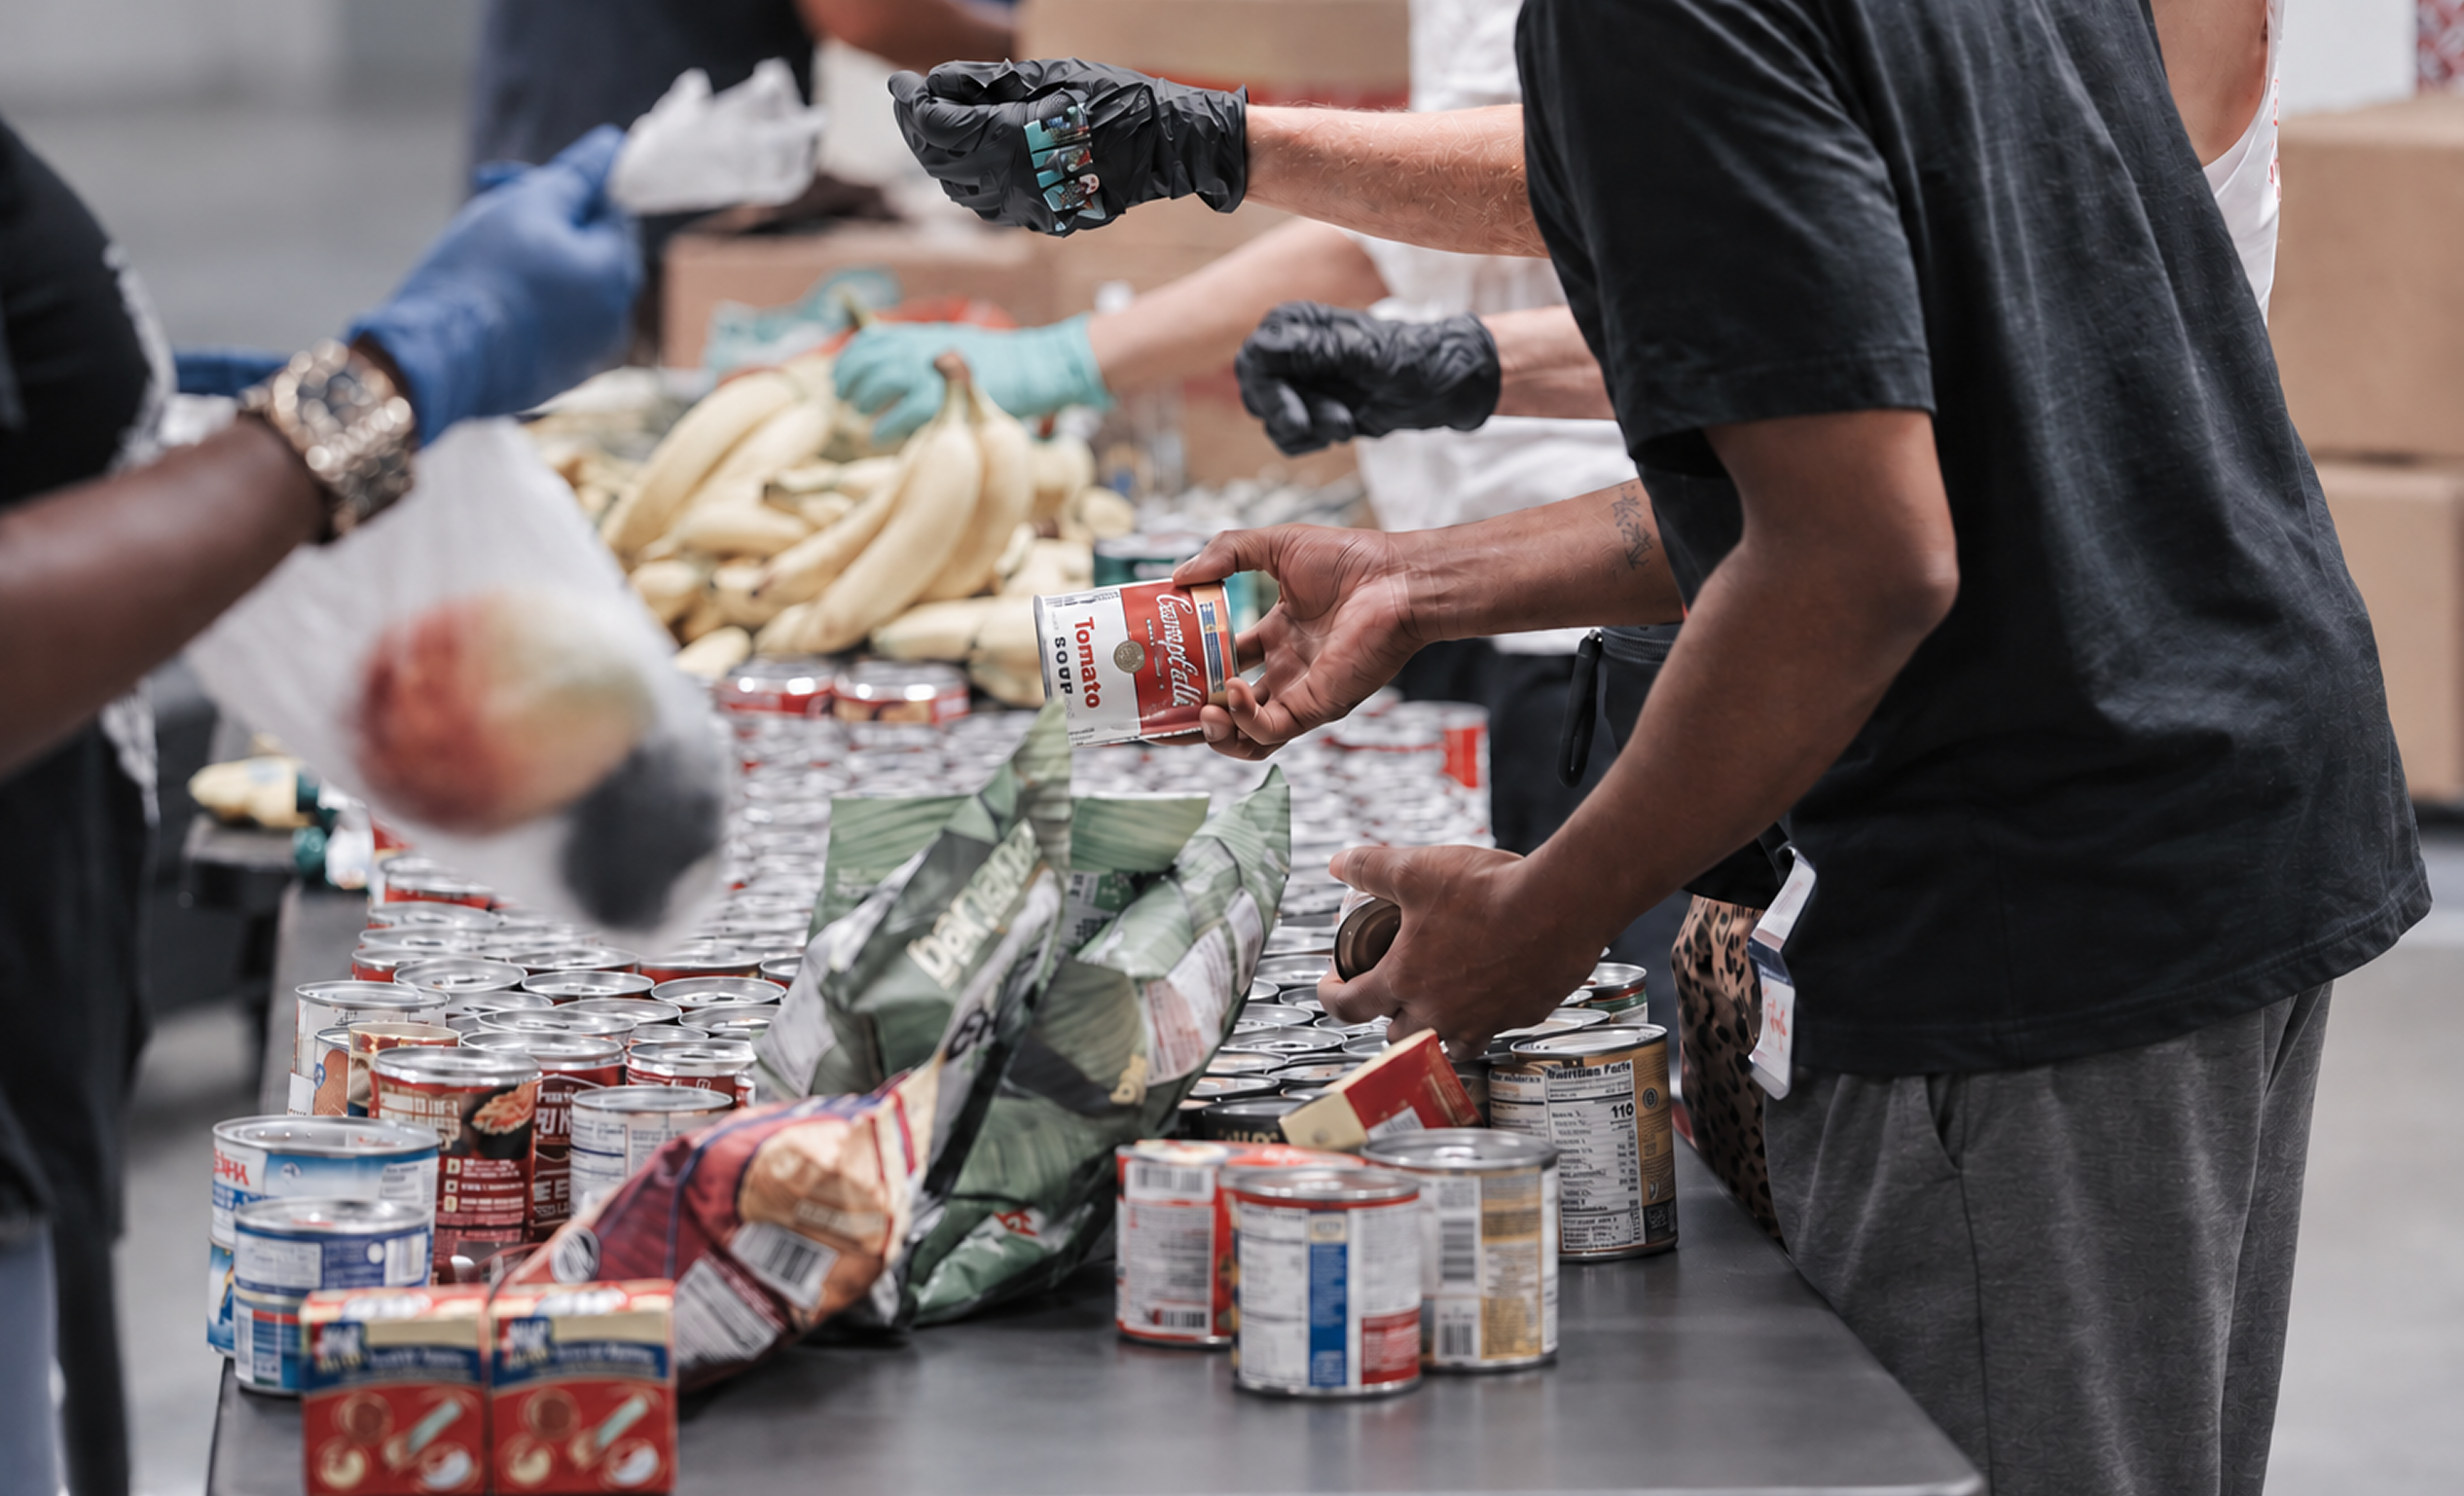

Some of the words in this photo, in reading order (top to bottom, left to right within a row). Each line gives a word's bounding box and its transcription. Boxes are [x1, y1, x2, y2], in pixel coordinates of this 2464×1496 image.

[1054, 637, 1073, 694] SOUP
[1074, 616, 1102, 709] Tomato
[1611, 1102, 1634, 1118] 110
